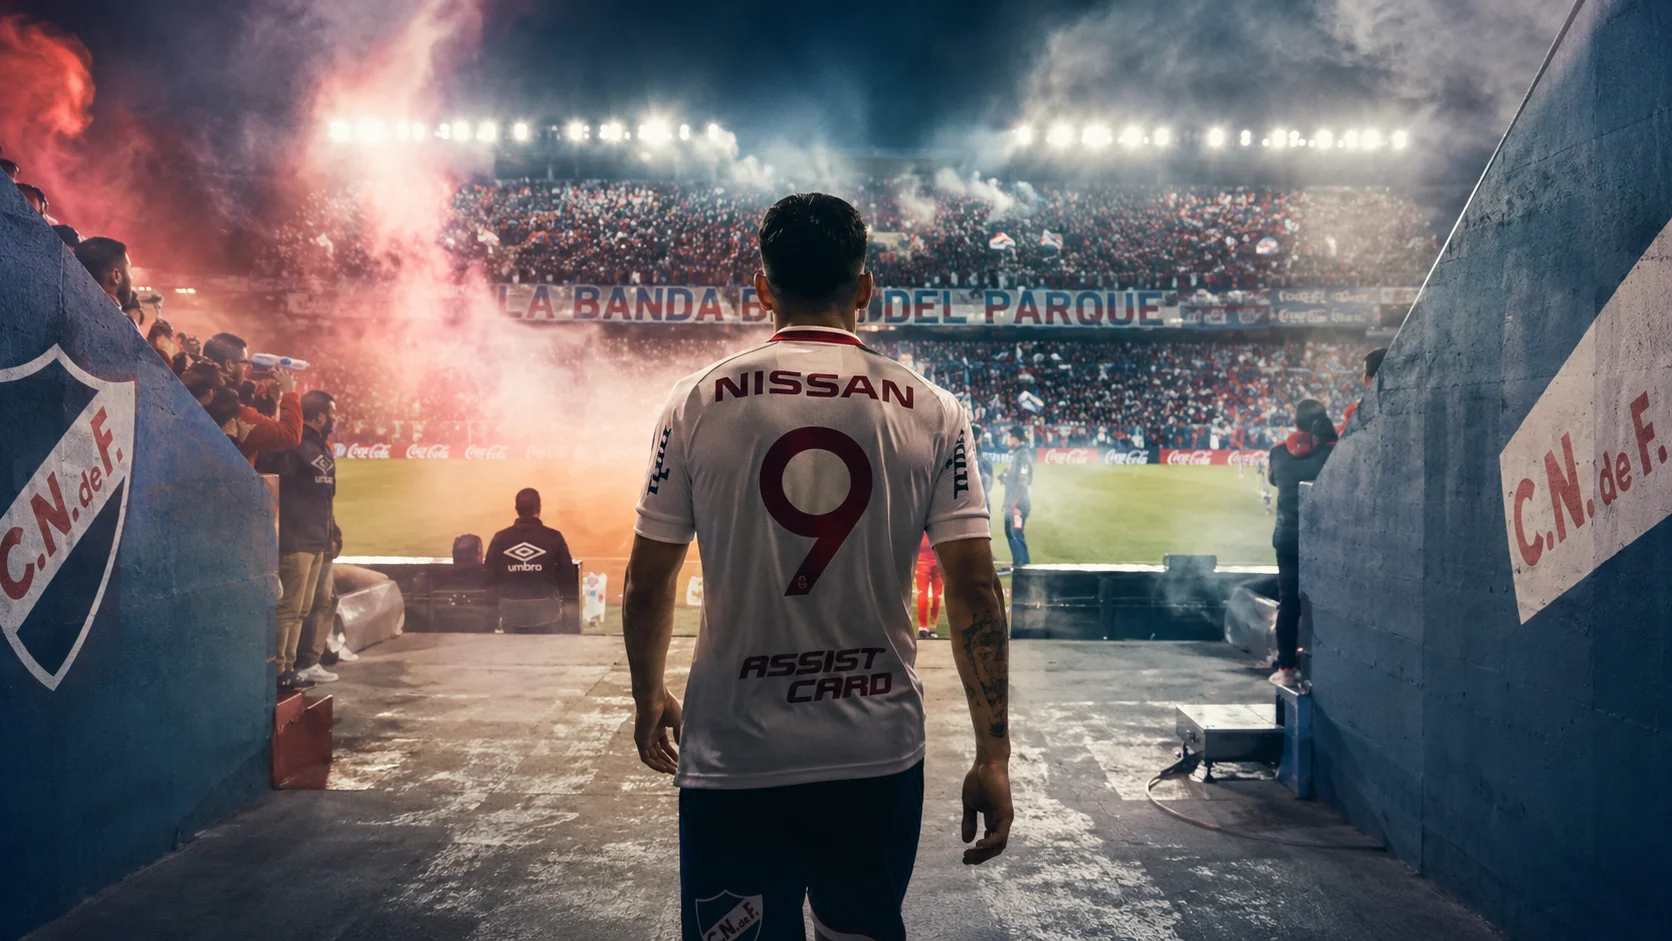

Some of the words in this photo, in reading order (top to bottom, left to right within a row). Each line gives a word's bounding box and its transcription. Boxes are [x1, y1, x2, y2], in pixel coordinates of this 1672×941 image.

[499, 285, 556, 320] LA
[572, 286, 724, 323] BANDA
[883, 289, 967, 324] DEL
[984, 289, 1165, 327] PARQUE
[714, 370, 914, 410] NISSAN
[759, 426, 873, 597] 9
[507, 561, 543, 573] umbro
[738, 647, 887, 680] ASSIST
[786, 671, 893, 704] CARD
